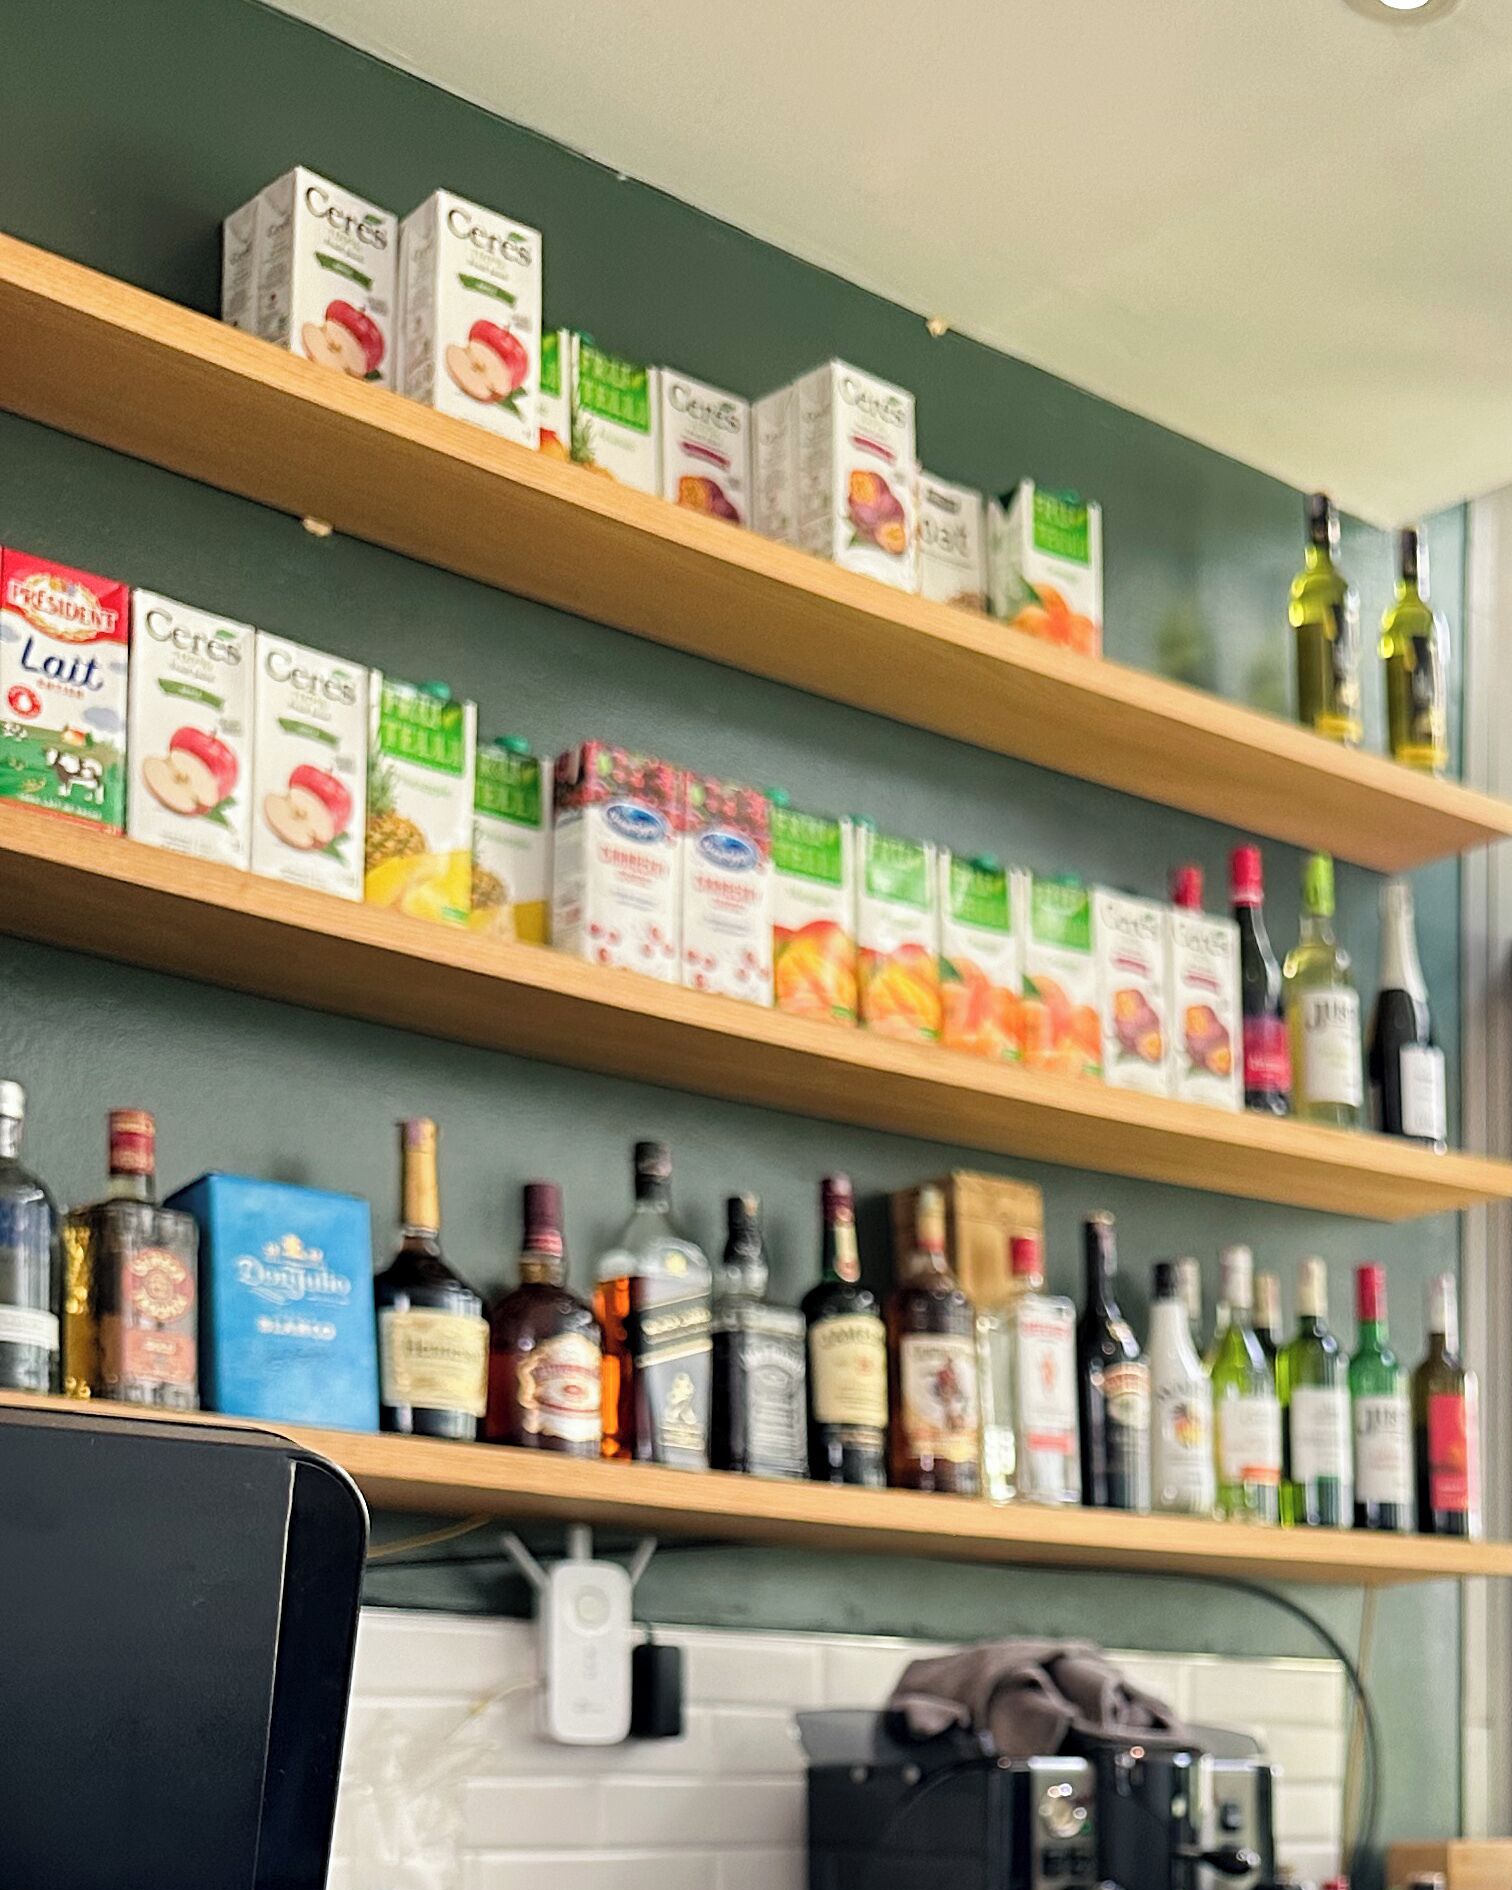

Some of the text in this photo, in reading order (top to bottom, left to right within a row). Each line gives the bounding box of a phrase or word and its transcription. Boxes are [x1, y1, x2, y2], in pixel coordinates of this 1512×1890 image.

[305, 187, 387, 250] Ceres
[447, 206, 532, 267] Ceres
[20, 636, 104, 692] Lait
[145, 607, 242, 666] Ceres
[265, 647, 357, 706] Ceres
